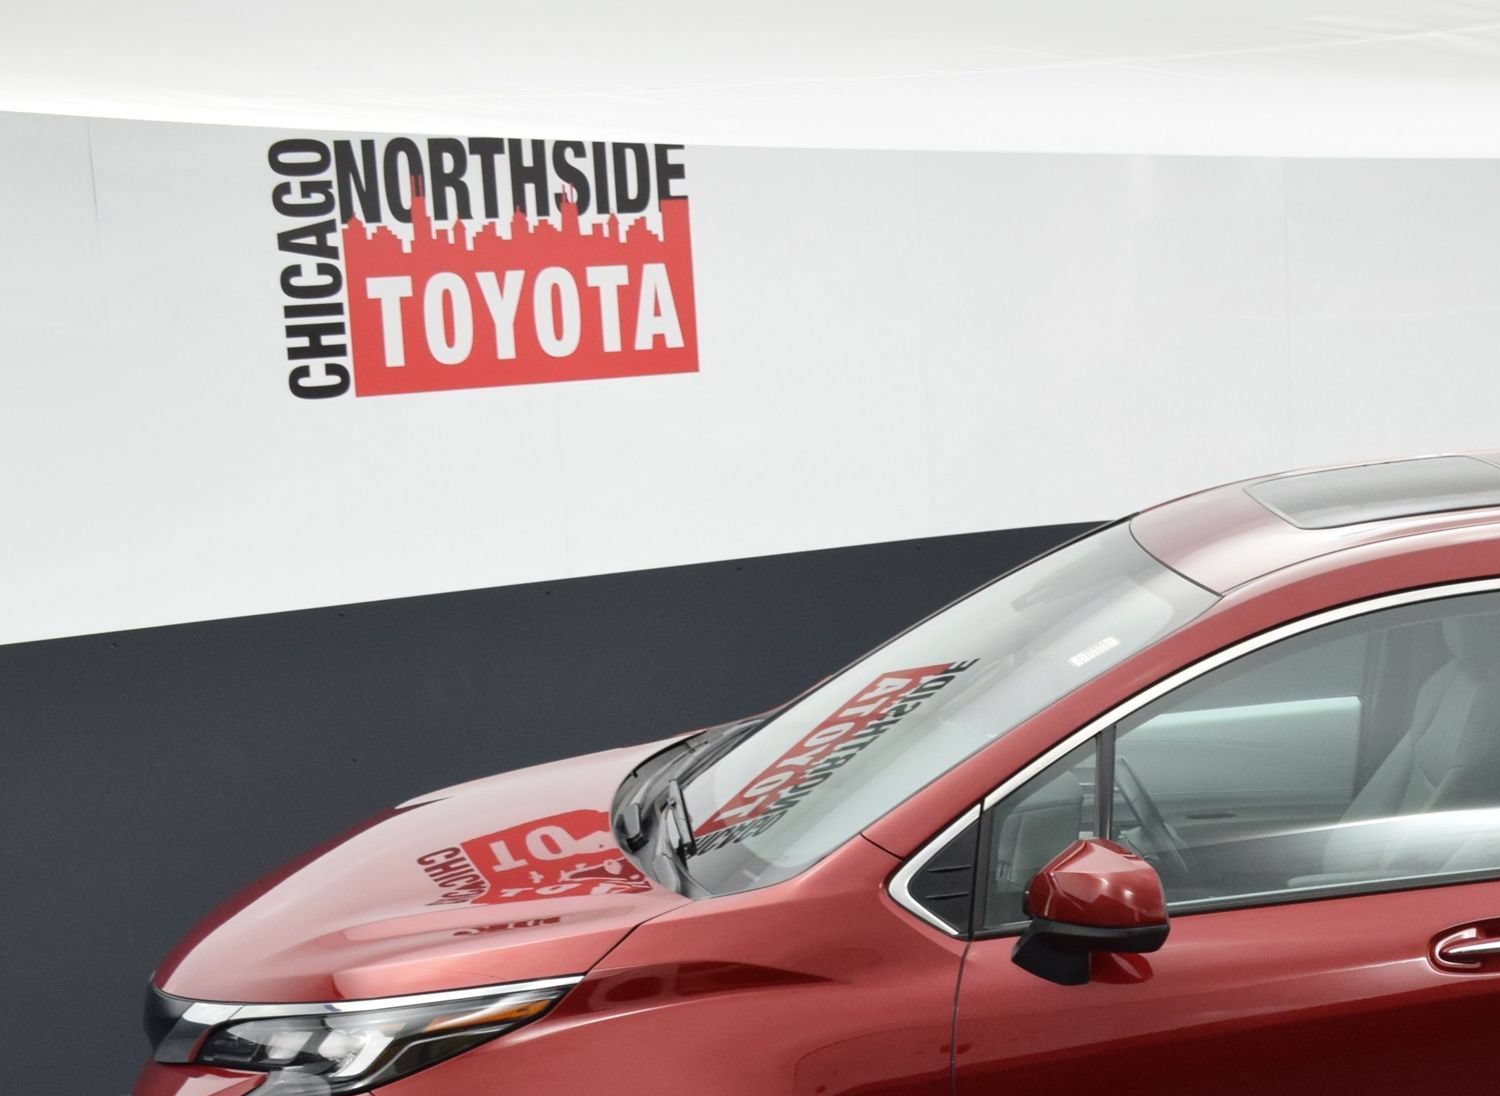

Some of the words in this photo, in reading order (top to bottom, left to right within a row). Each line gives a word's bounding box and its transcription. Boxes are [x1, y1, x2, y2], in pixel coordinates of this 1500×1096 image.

[333, 137, 686, 223] NORTHSIDE
[268, 138, 351, 400] CHICAGO
[366, 262, 685, 367] TOYOTA
